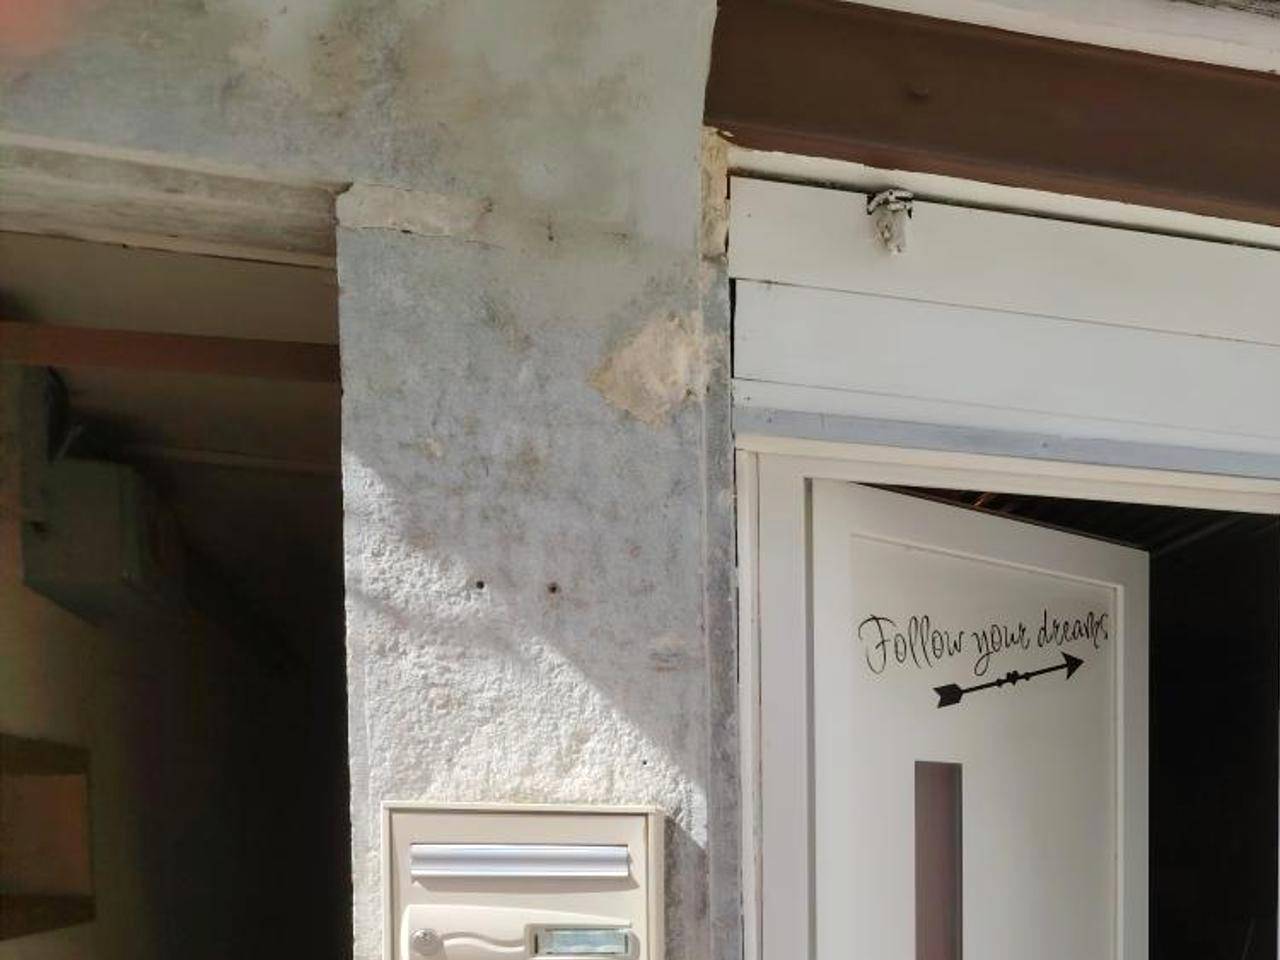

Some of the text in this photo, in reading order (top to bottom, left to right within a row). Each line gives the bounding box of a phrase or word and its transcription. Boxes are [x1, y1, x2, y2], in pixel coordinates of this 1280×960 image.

[858, 609, 1109, 676] Follow your dreams
